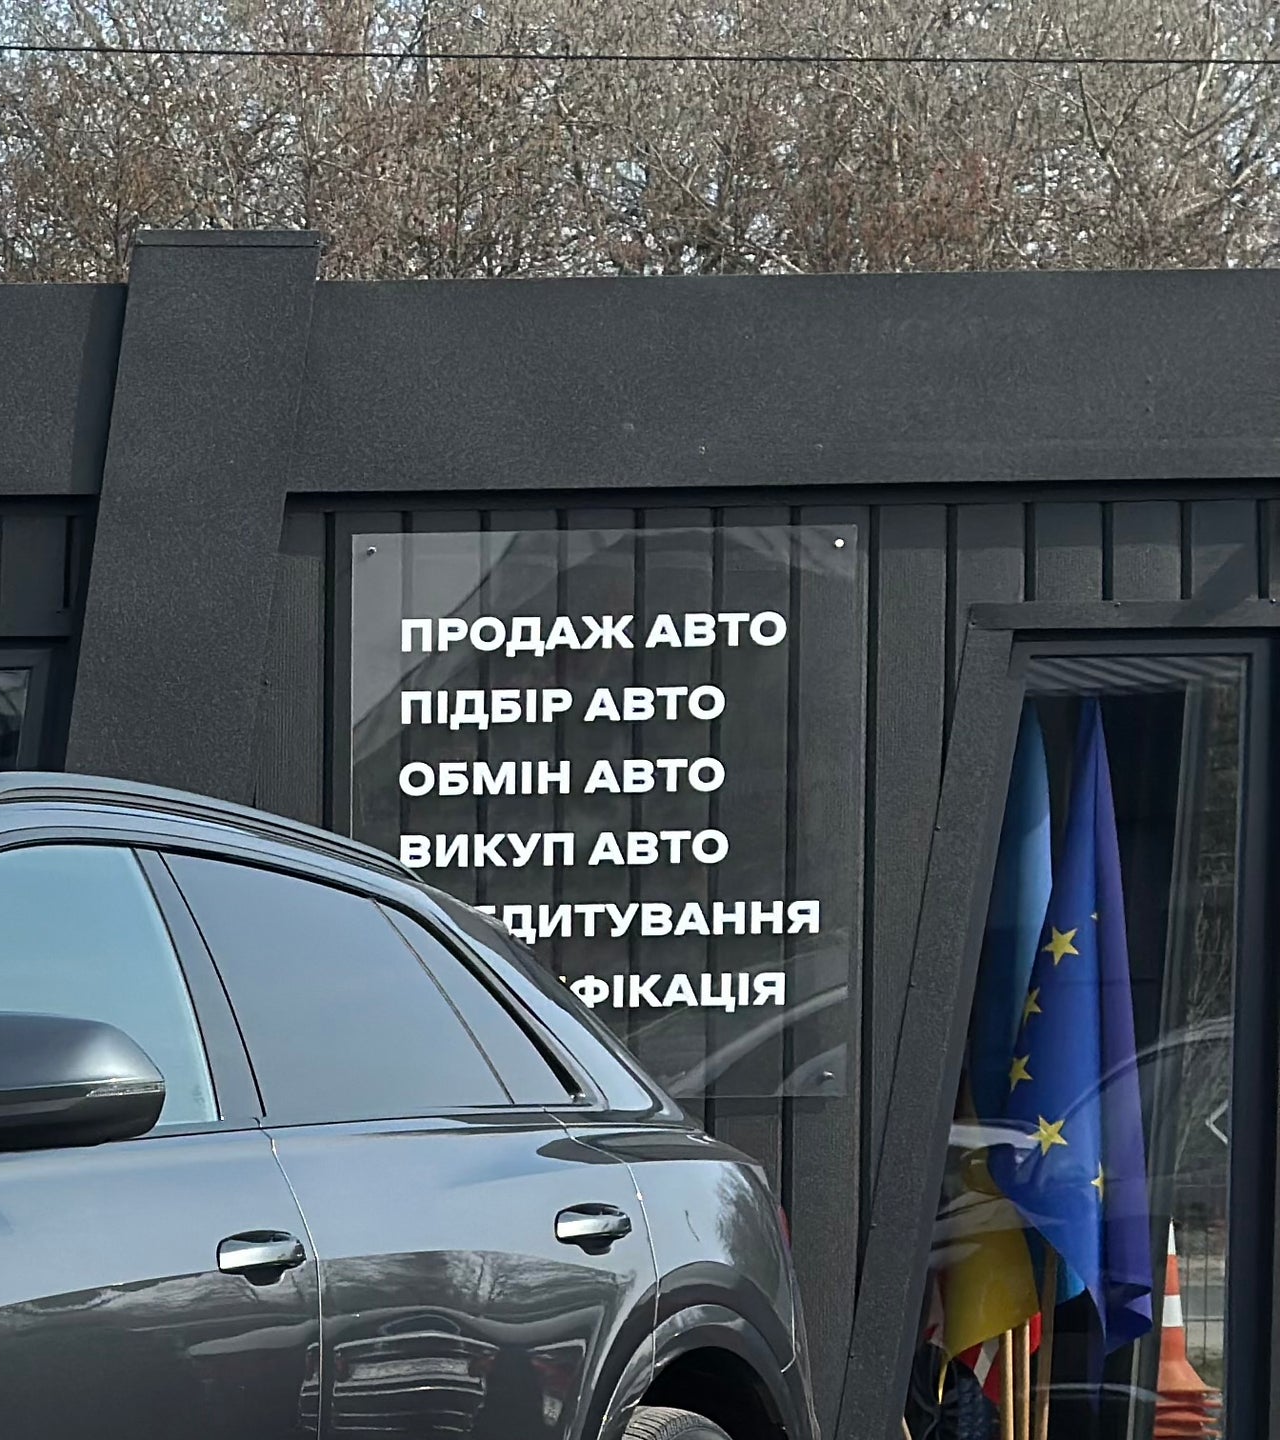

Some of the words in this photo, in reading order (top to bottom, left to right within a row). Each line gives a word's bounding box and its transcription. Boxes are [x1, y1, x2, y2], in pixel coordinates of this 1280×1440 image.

[400, 614, 634, 657] ПРОДАЖ
[645, 611, 787, 648] АВТО
[400, 688, 573, 731] ПІДБІР
[583, 685, 726, 722] АВТО
[399, 760, 571, 797] ОБМІН
[583, 757, 726, 794] АВТО
[400, 832, 575, 868] ВИКУП
[588, 829, 729, 865] АВТО
[560, 972, 786, 1013] ФІКАЦІЯ
